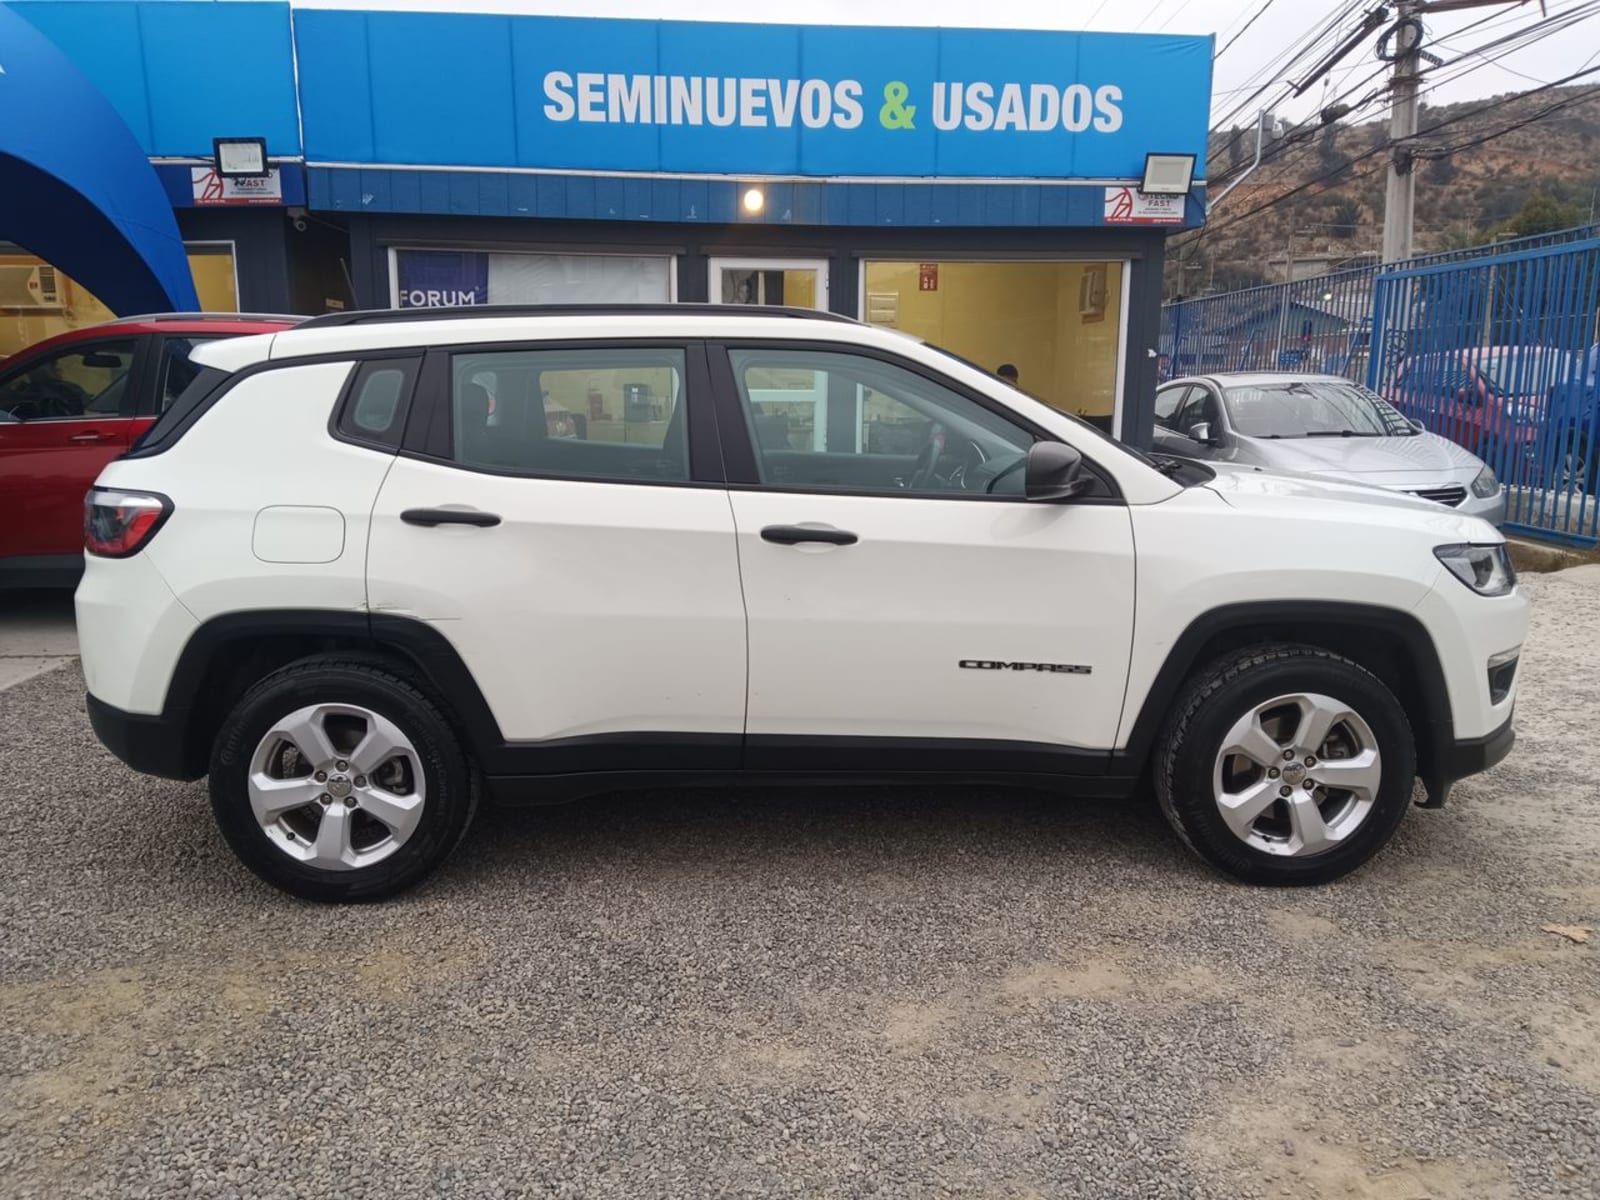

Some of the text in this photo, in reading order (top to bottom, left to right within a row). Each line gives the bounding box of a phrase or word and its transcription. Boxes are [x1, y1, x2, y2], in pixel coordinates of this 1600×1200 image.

[543, 71, 1123, 133] SEMINUEVOS & USADOS
[1147, 199, 1171, 207] FAST
[400, 289, 475, 307] FORUM
[958, 659, 1092, 675] COMPASS
